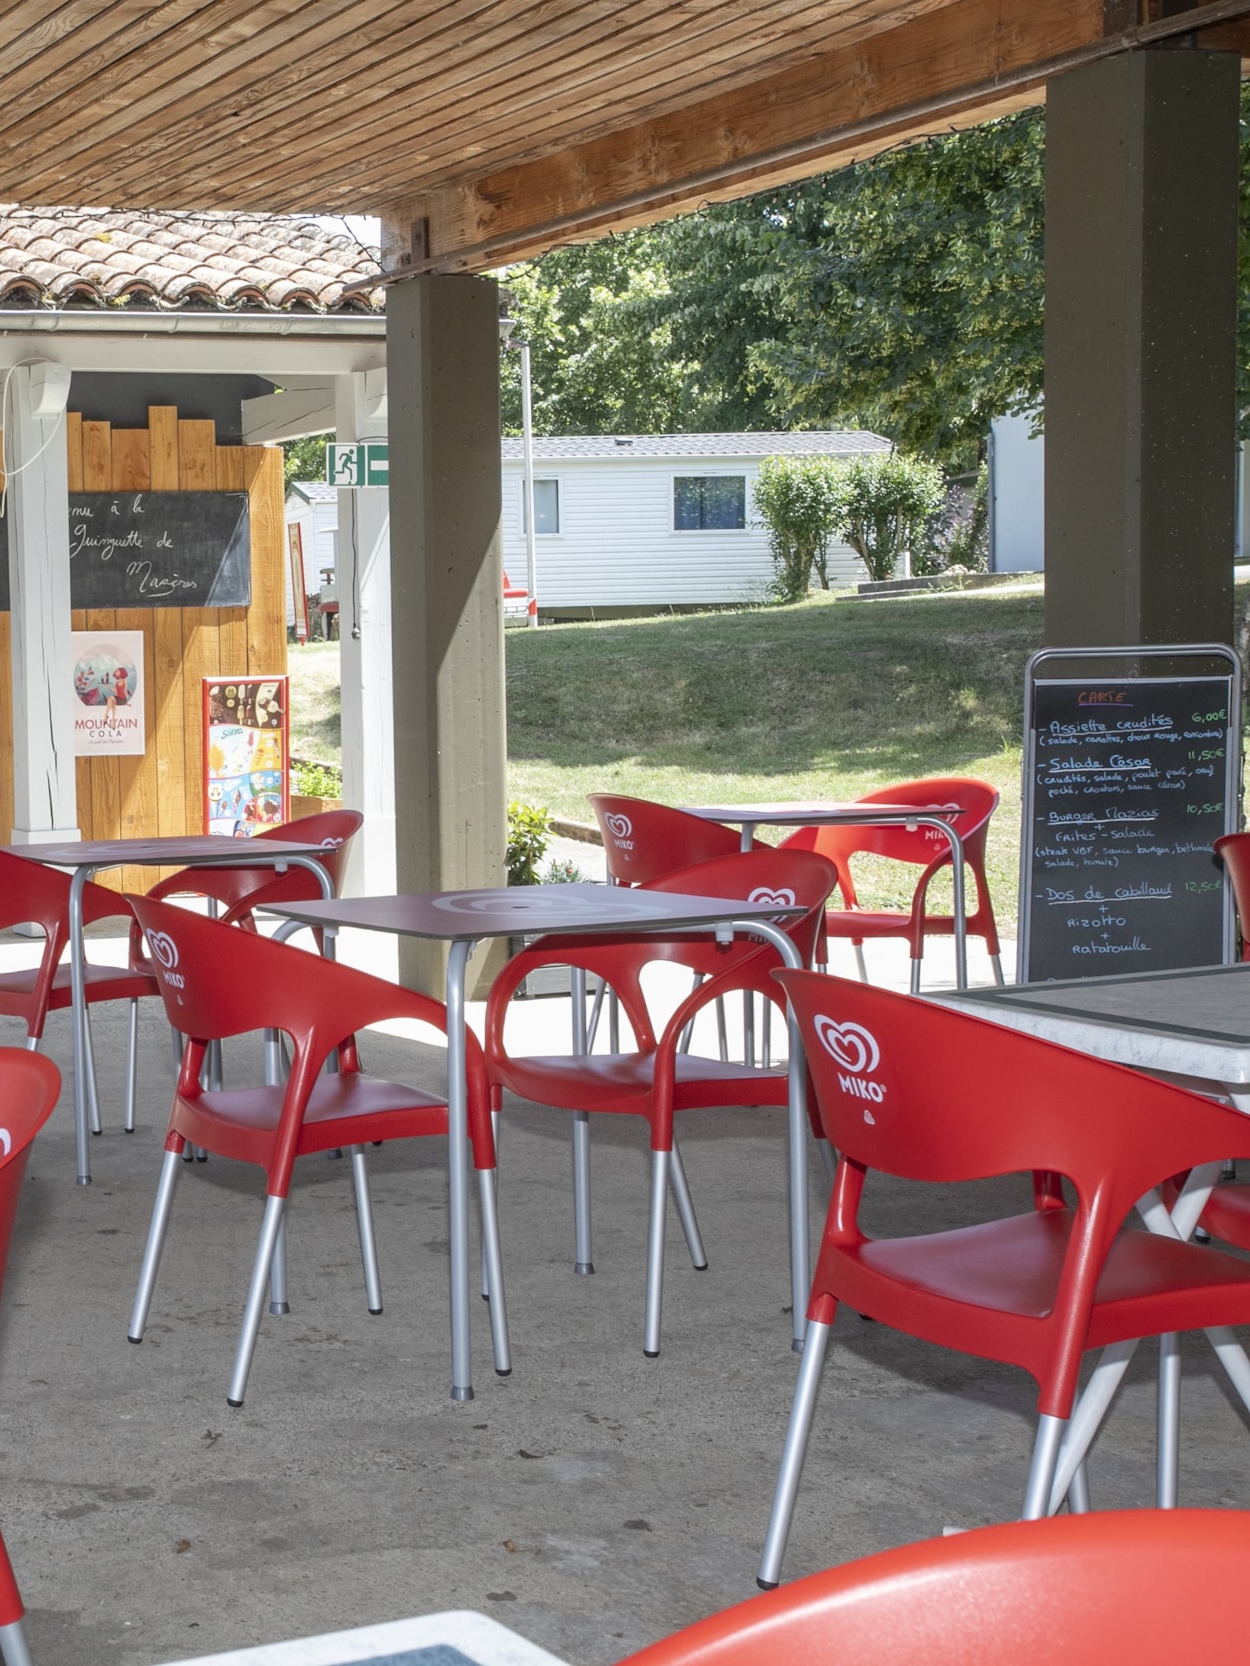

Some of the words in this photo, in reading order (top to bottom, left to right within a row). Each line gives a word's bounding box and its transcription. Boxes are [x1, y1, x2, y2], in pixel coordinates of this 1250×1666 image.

[132, 493, 145, 513] la
[156, 531, 173, 548] de
[1078, 691, 1127, 704] CARTE
[1191, 709, 1227, 724] 6,00€
[74, 719, 138, 730] MOUNTAIN
[89, 730, 122, 738] COLA
[1050, 757, 1102, 771] Salade
[1188, 747, 1225, 761] 11,50€
[1186, 803, 1224, 815] 10,50€
[925, 830, 944, 840] MIK
[1084, 885, 1105, 899] de
